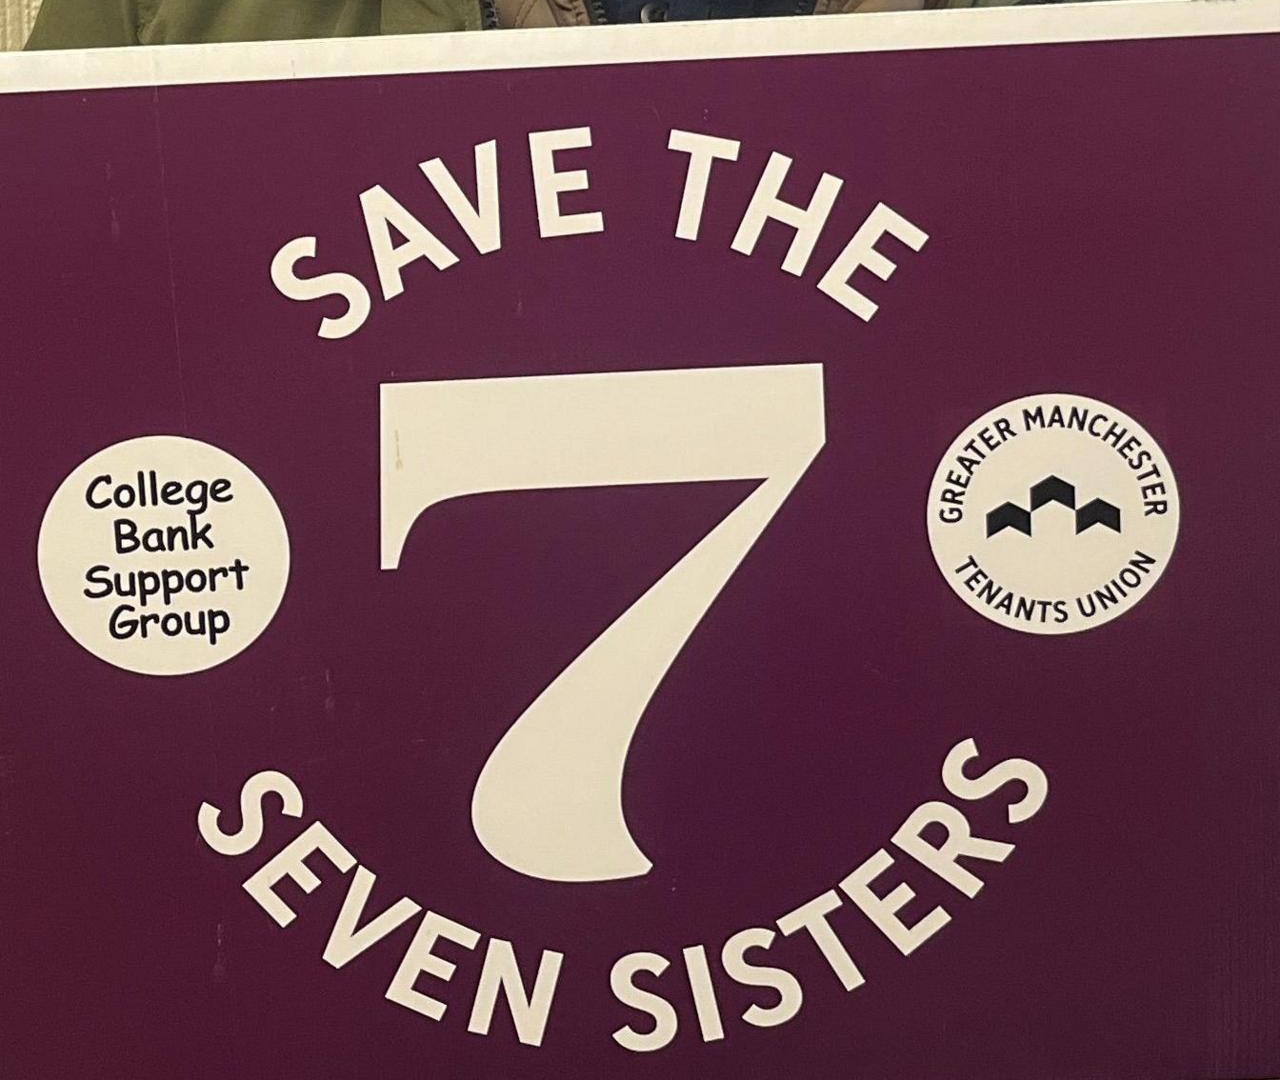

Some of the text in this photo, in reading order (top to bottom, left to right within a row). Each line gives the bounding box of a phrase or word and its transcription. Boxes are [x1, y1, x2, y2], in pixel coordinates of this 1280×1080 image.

[271, 127, 929, 338] SAVE THE
[85, 470, 234, 515] College
[939, 405, 1168, 524] GREATER MANCHESTER
[113, 514, 215, 554] Bank
[83, 559, 250, 607] Support
[954, 550, 1157, 623] TENANTS UNION
[109, 604, 231, 646] Group
[380, 363, 825, 881] 7
[198, 738, 1047, 1051] SEVEN SISTERS
